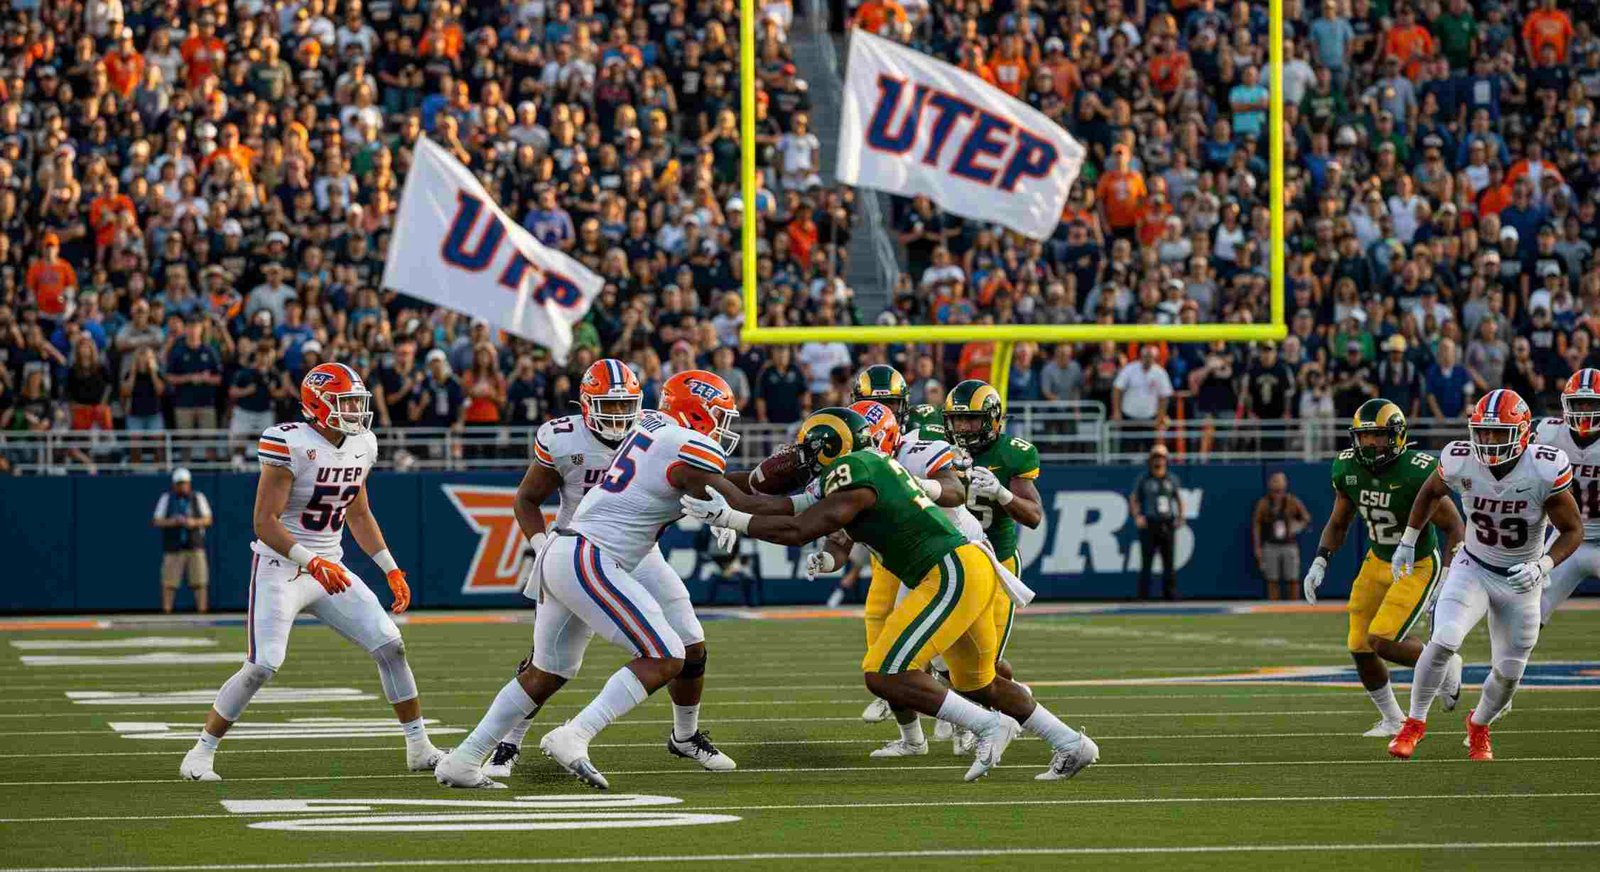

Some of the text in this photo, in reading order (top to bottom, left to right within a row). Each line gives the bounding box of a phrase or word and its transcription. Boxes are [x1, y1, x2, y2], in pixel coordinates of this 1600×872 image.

[866, 74, 1059, 193] UTEP
[316, 467, 363, 483] UTEP
[824, 463, 852, 497] 29
[1360, 489, 1392, 508] CSU
[1473, 496, 1529, 514] UTEP
[1470, 511, 1529, 549] 33
